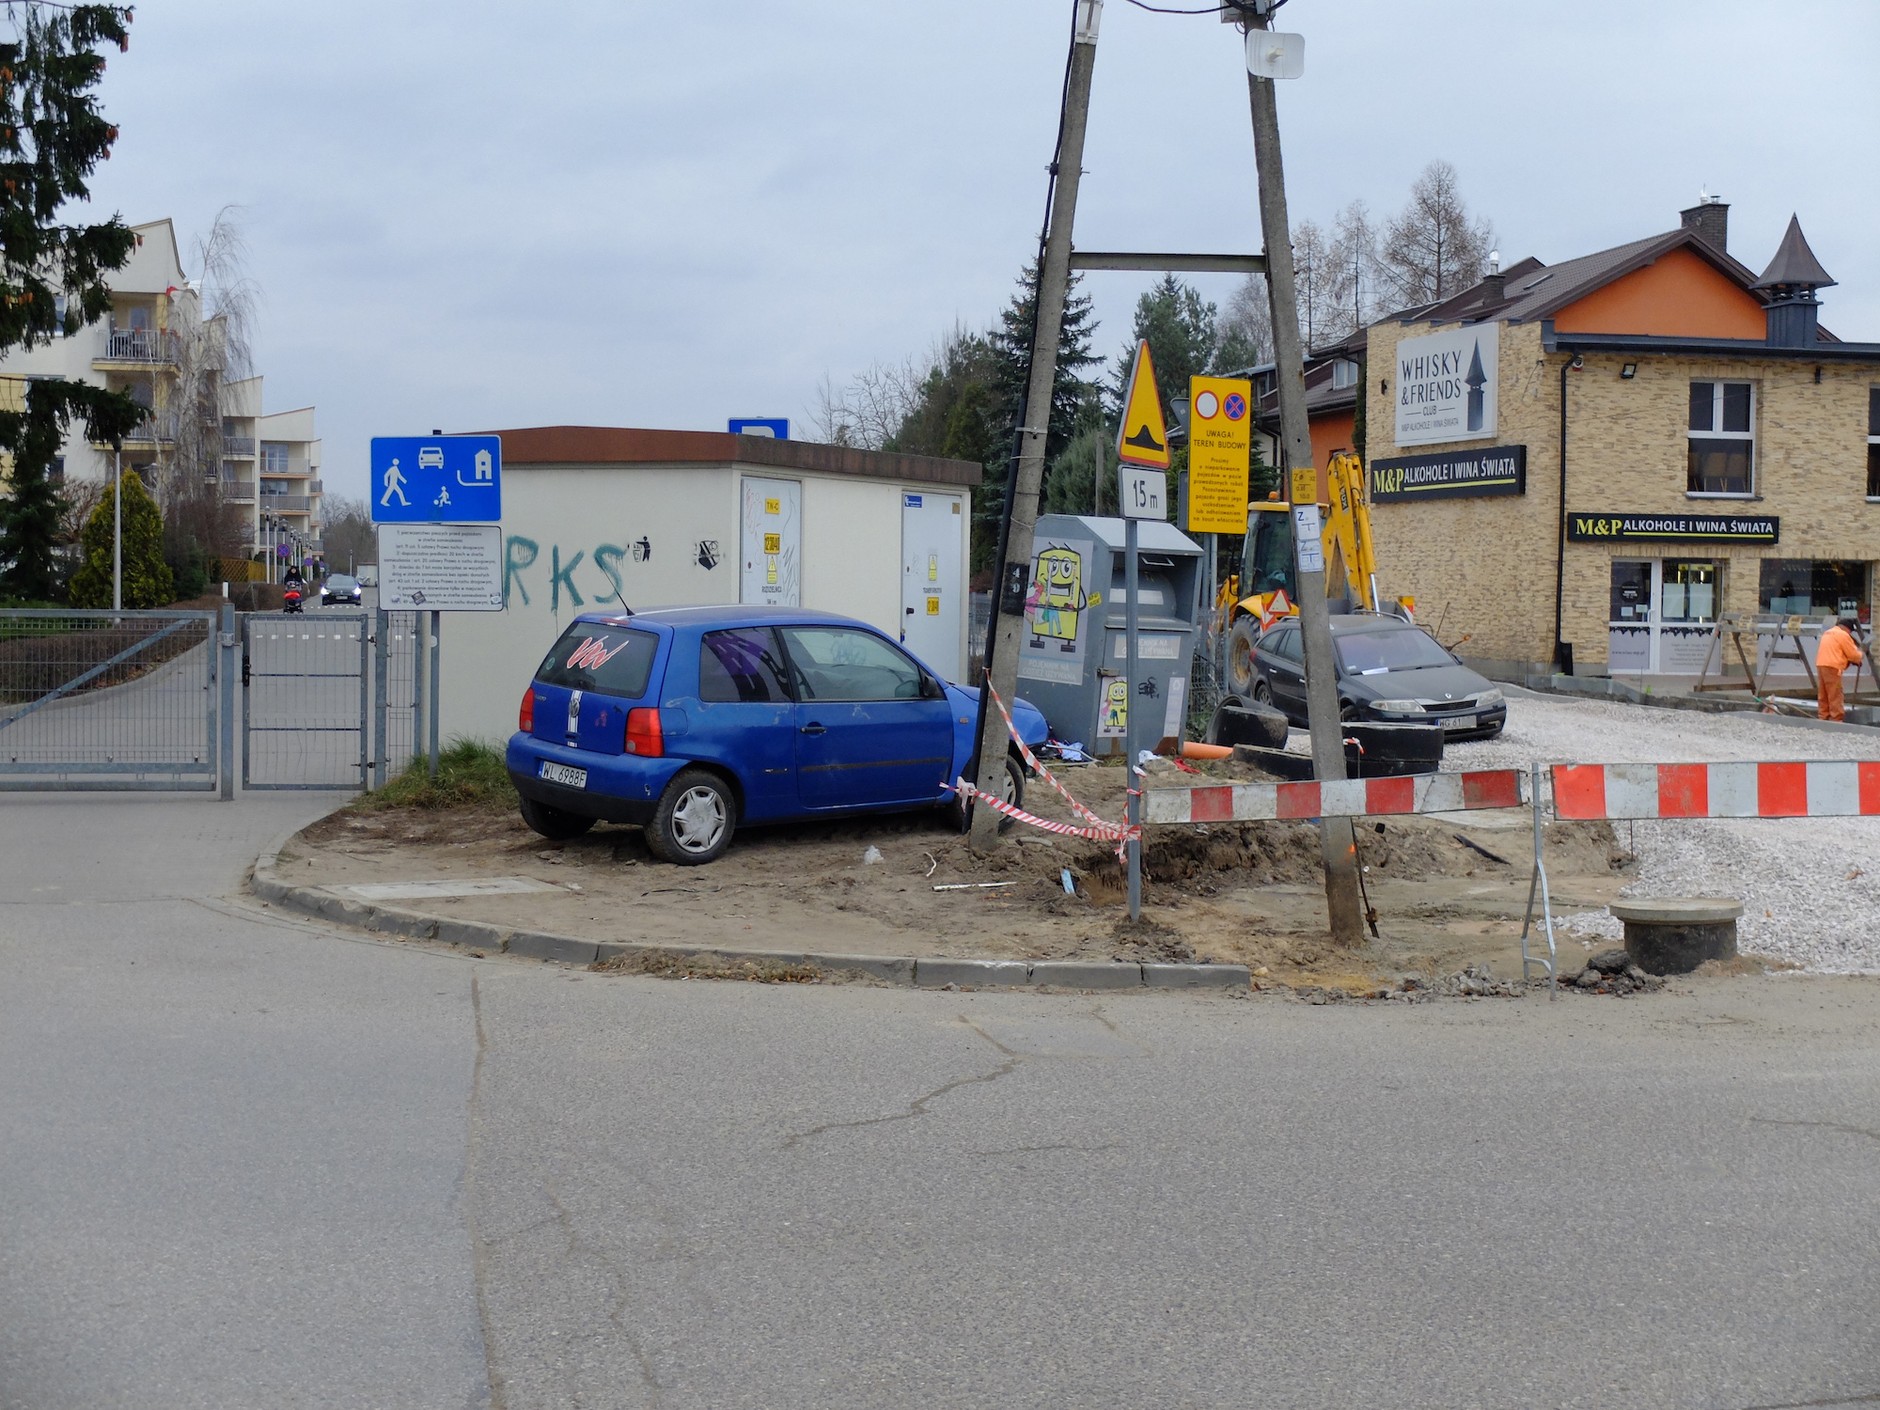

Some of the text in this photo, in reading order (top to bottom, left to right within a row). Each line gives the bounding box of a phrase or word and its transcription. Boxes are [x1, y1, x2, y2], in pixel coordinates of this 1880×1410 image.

[1401, 350, 1462, 382] WHISKY
[1401, 378, 1462, 406] &FRIENDS
[1422, 405, 1437, 416] CLUB
[1206, 430, 1234, 438] UWAGA!
[1409, 420, 1430, 431] ALKOHOLE
[1193, 439, 1246, 450] TEREN BUDOWY
[1373, 456, 1516, 493] M&P ALKOHOLE I WINA ŚWIATA
[1133, 480, 1158, 509] 15 m
[1297, 511, 1304, 522] Z
[1576, 518, 1774, 536] M&P ALKOHOLE I WINA ŚWIATA
[502, 534, 628, 610] RKS
[542, 763, 586, 786] WL 6988F
